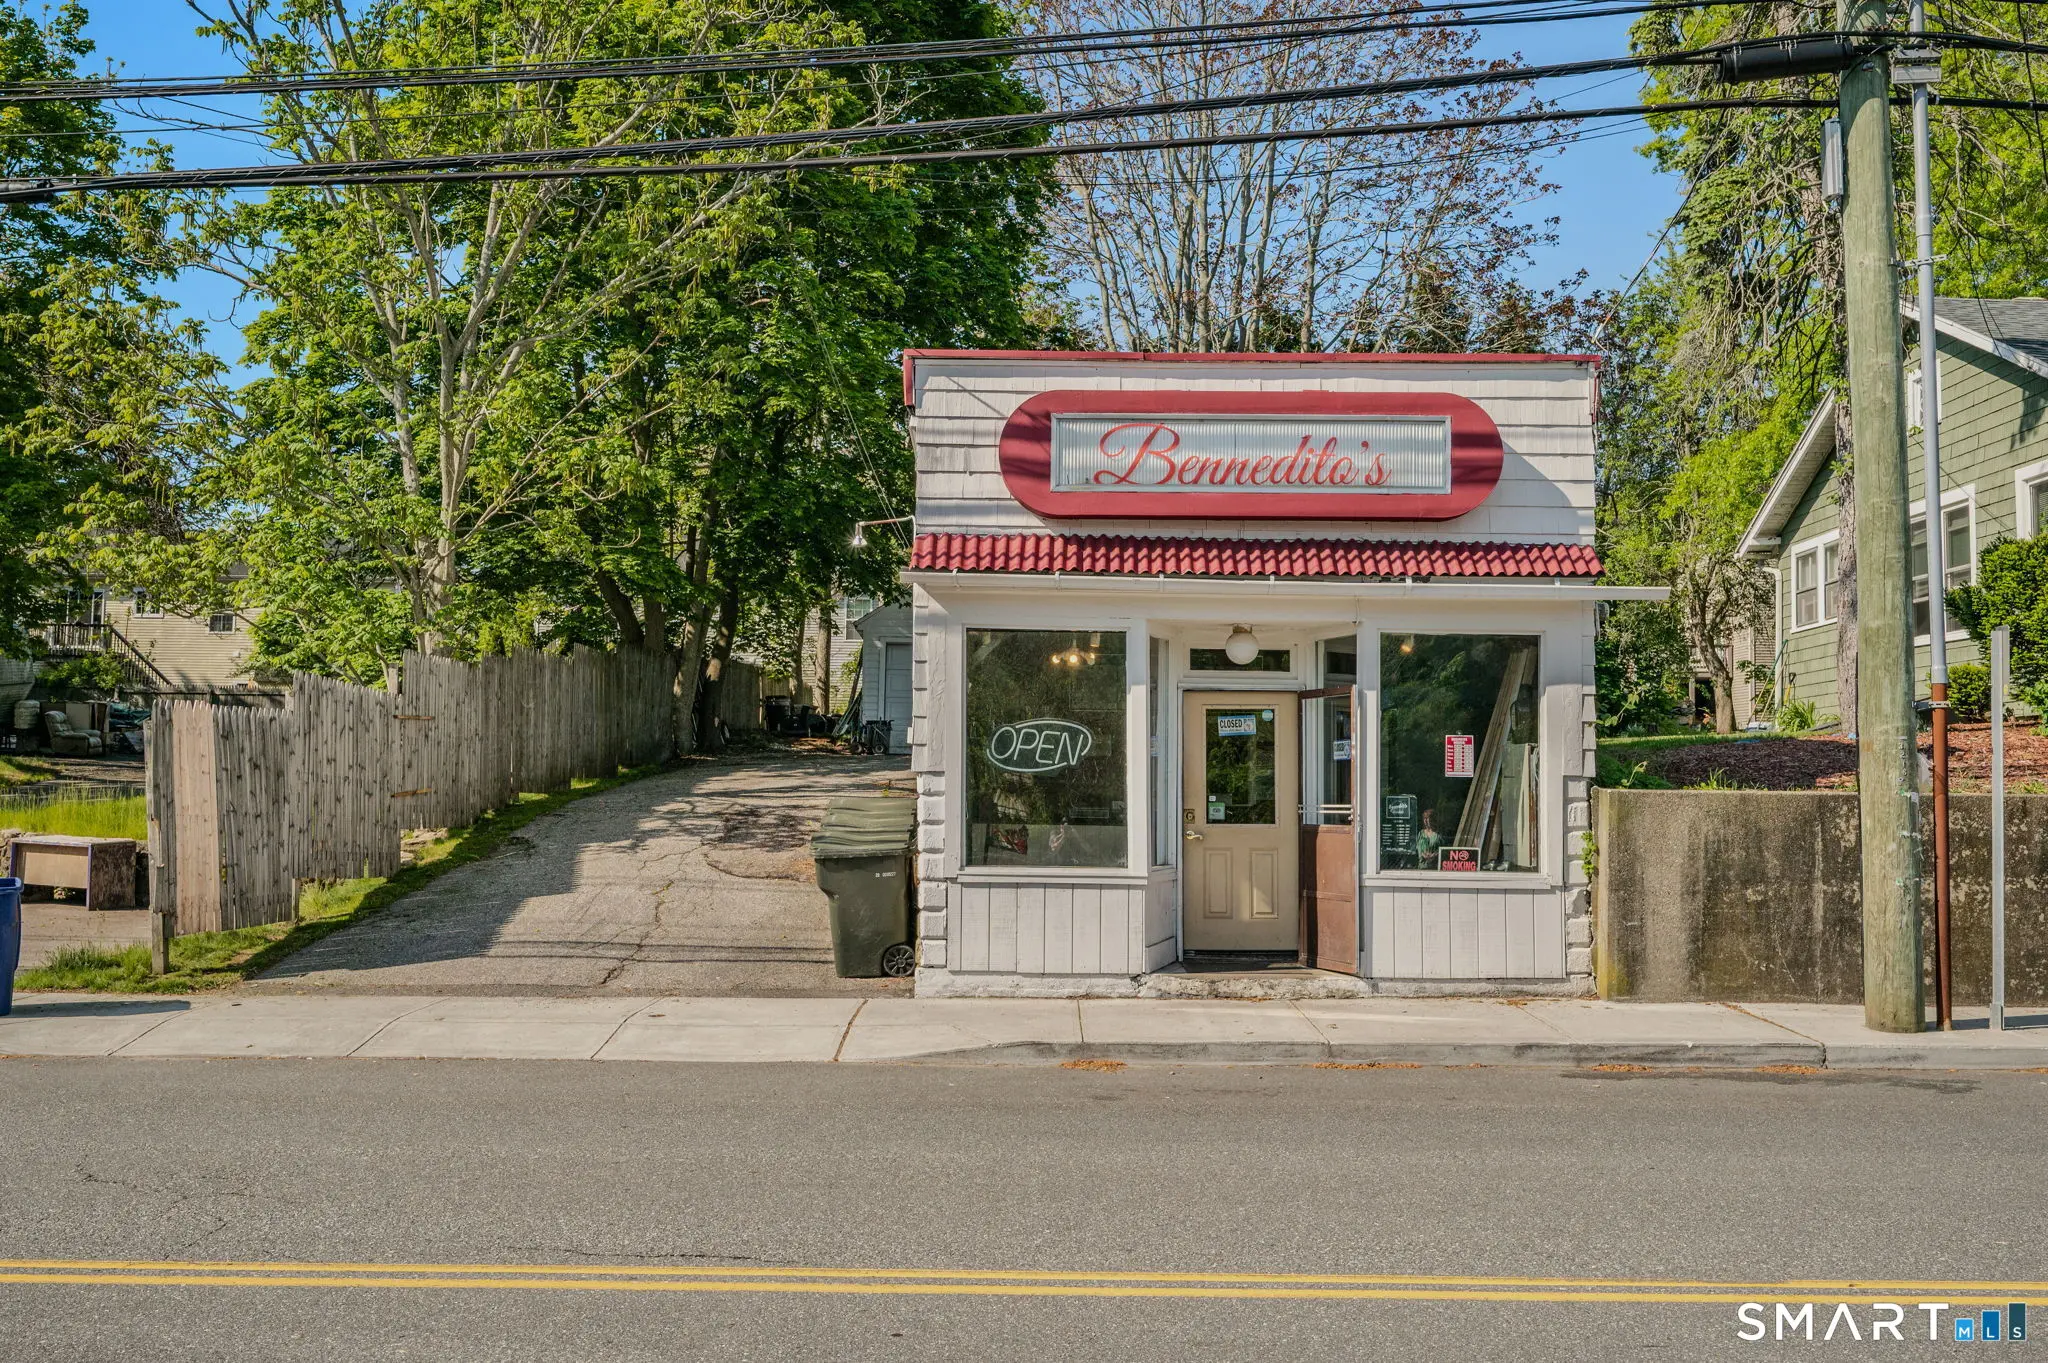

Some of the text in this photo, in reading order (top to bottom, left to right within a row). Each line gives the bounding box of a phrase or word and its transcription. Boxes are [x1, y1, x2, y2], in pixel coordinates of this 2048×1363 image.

[1093, 422, 1392, 486] Bennedito's
[1219, 719, 1243, 729] CLOSED
[991, 726, 1084, 765] OPEN
[1450, 850, 1469, 861] NO
[1442, 860, 1477, 872] SMOKING
